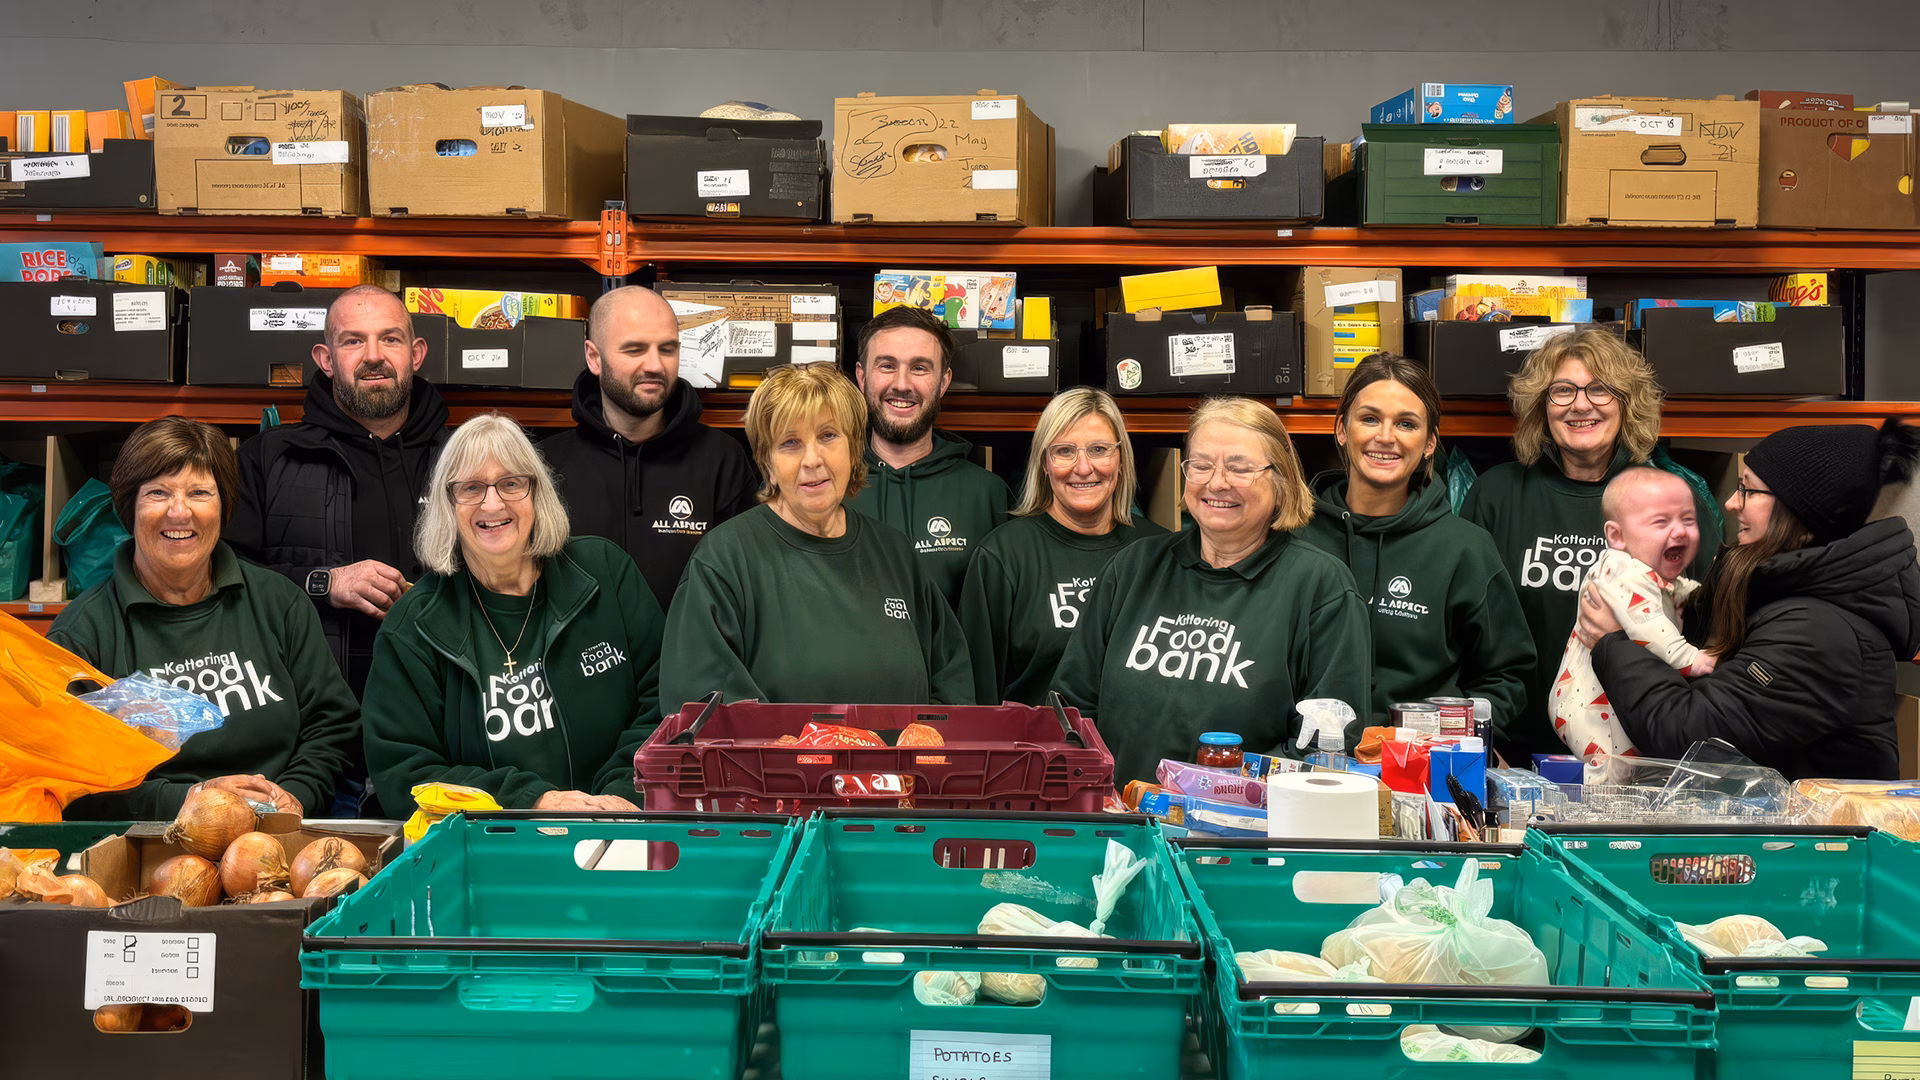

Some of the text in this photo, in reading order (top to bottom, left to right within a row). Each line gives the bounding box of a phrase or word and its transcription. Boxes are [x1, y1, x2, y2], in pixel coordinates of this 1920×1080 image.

[172, 95, 190, 117] 2
[20, 249, 67, 268] RICE
[1534, 537, 1597, 566] Foo
[1521, 548, 1581, 592] ba
[1148, 616, 1236, 655] Food
[580, 647, 627, 677] bank
[581, 642, 612, 664] Food
[1125, 625, 1255, 689] bank
[200, 660, 284, 717] nk
[490, 675, 545, 707] Foo
[934, 1047, 1012, 1063] POTATOES
